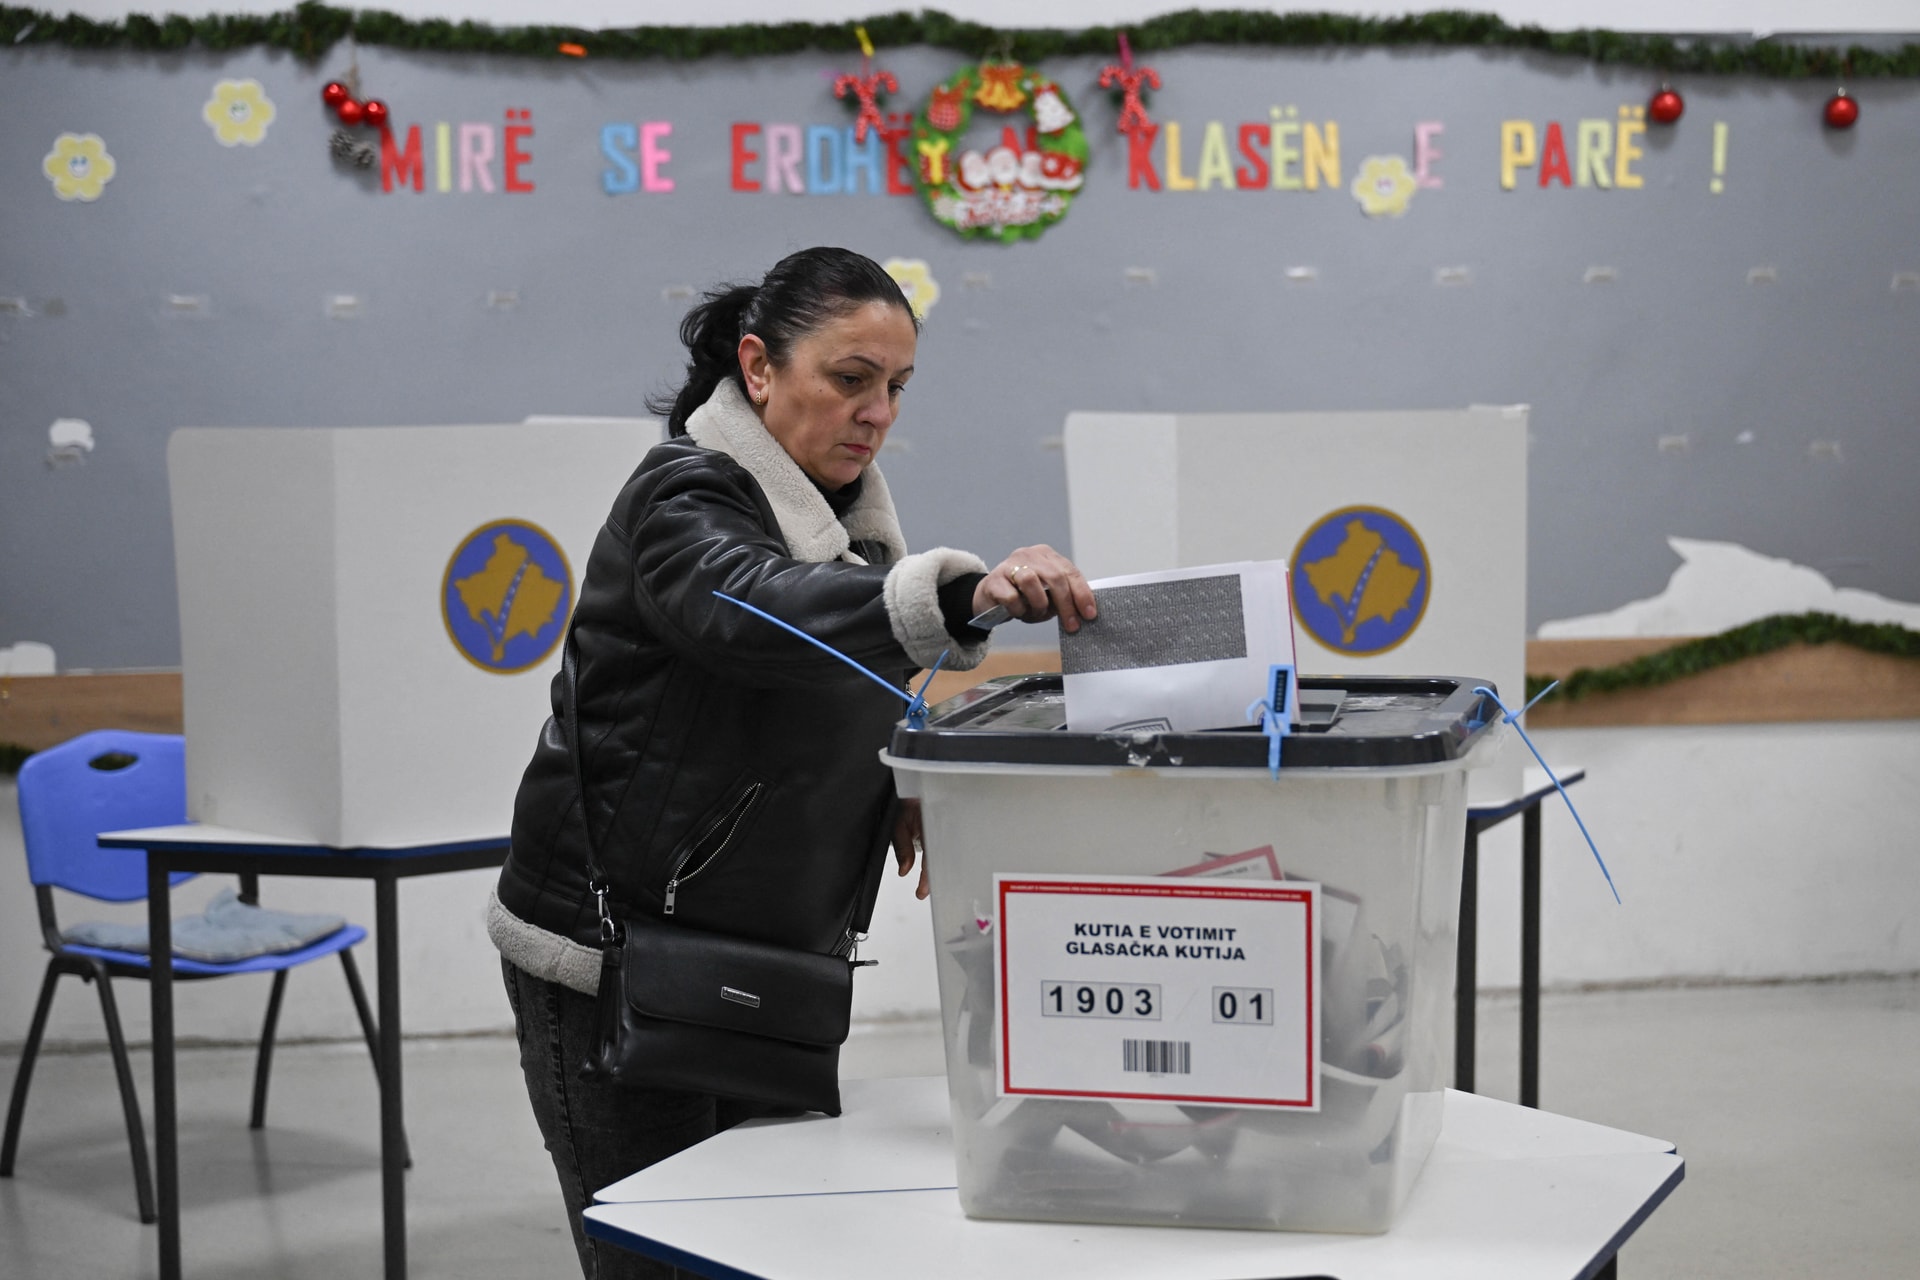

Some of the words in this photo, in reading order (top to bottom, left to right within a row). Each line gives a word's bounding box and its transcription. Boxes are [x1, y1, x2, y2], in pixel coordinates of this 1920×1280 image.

[380, 109, 535, 194] MIRË
[601, 121, 675, 195] SE
[1126, 106, 1341, 192] KLASËN
[1414, 121, 1445, 189] E
[1501, 105, 1646, 190] PARË
[1074, 923, 1134, 939] KUTIA
[1140, 925, 1151, 939] E
[1157, 925, 1237, 942] VOTIMIT
[1065, 940, 1169, 958] GLASAČKA
[1175, 945, 1247, 961] KUTIJA
[1049, 985, 1153, 1016] 1903
[1219, 992, 1264, 1021] 01
